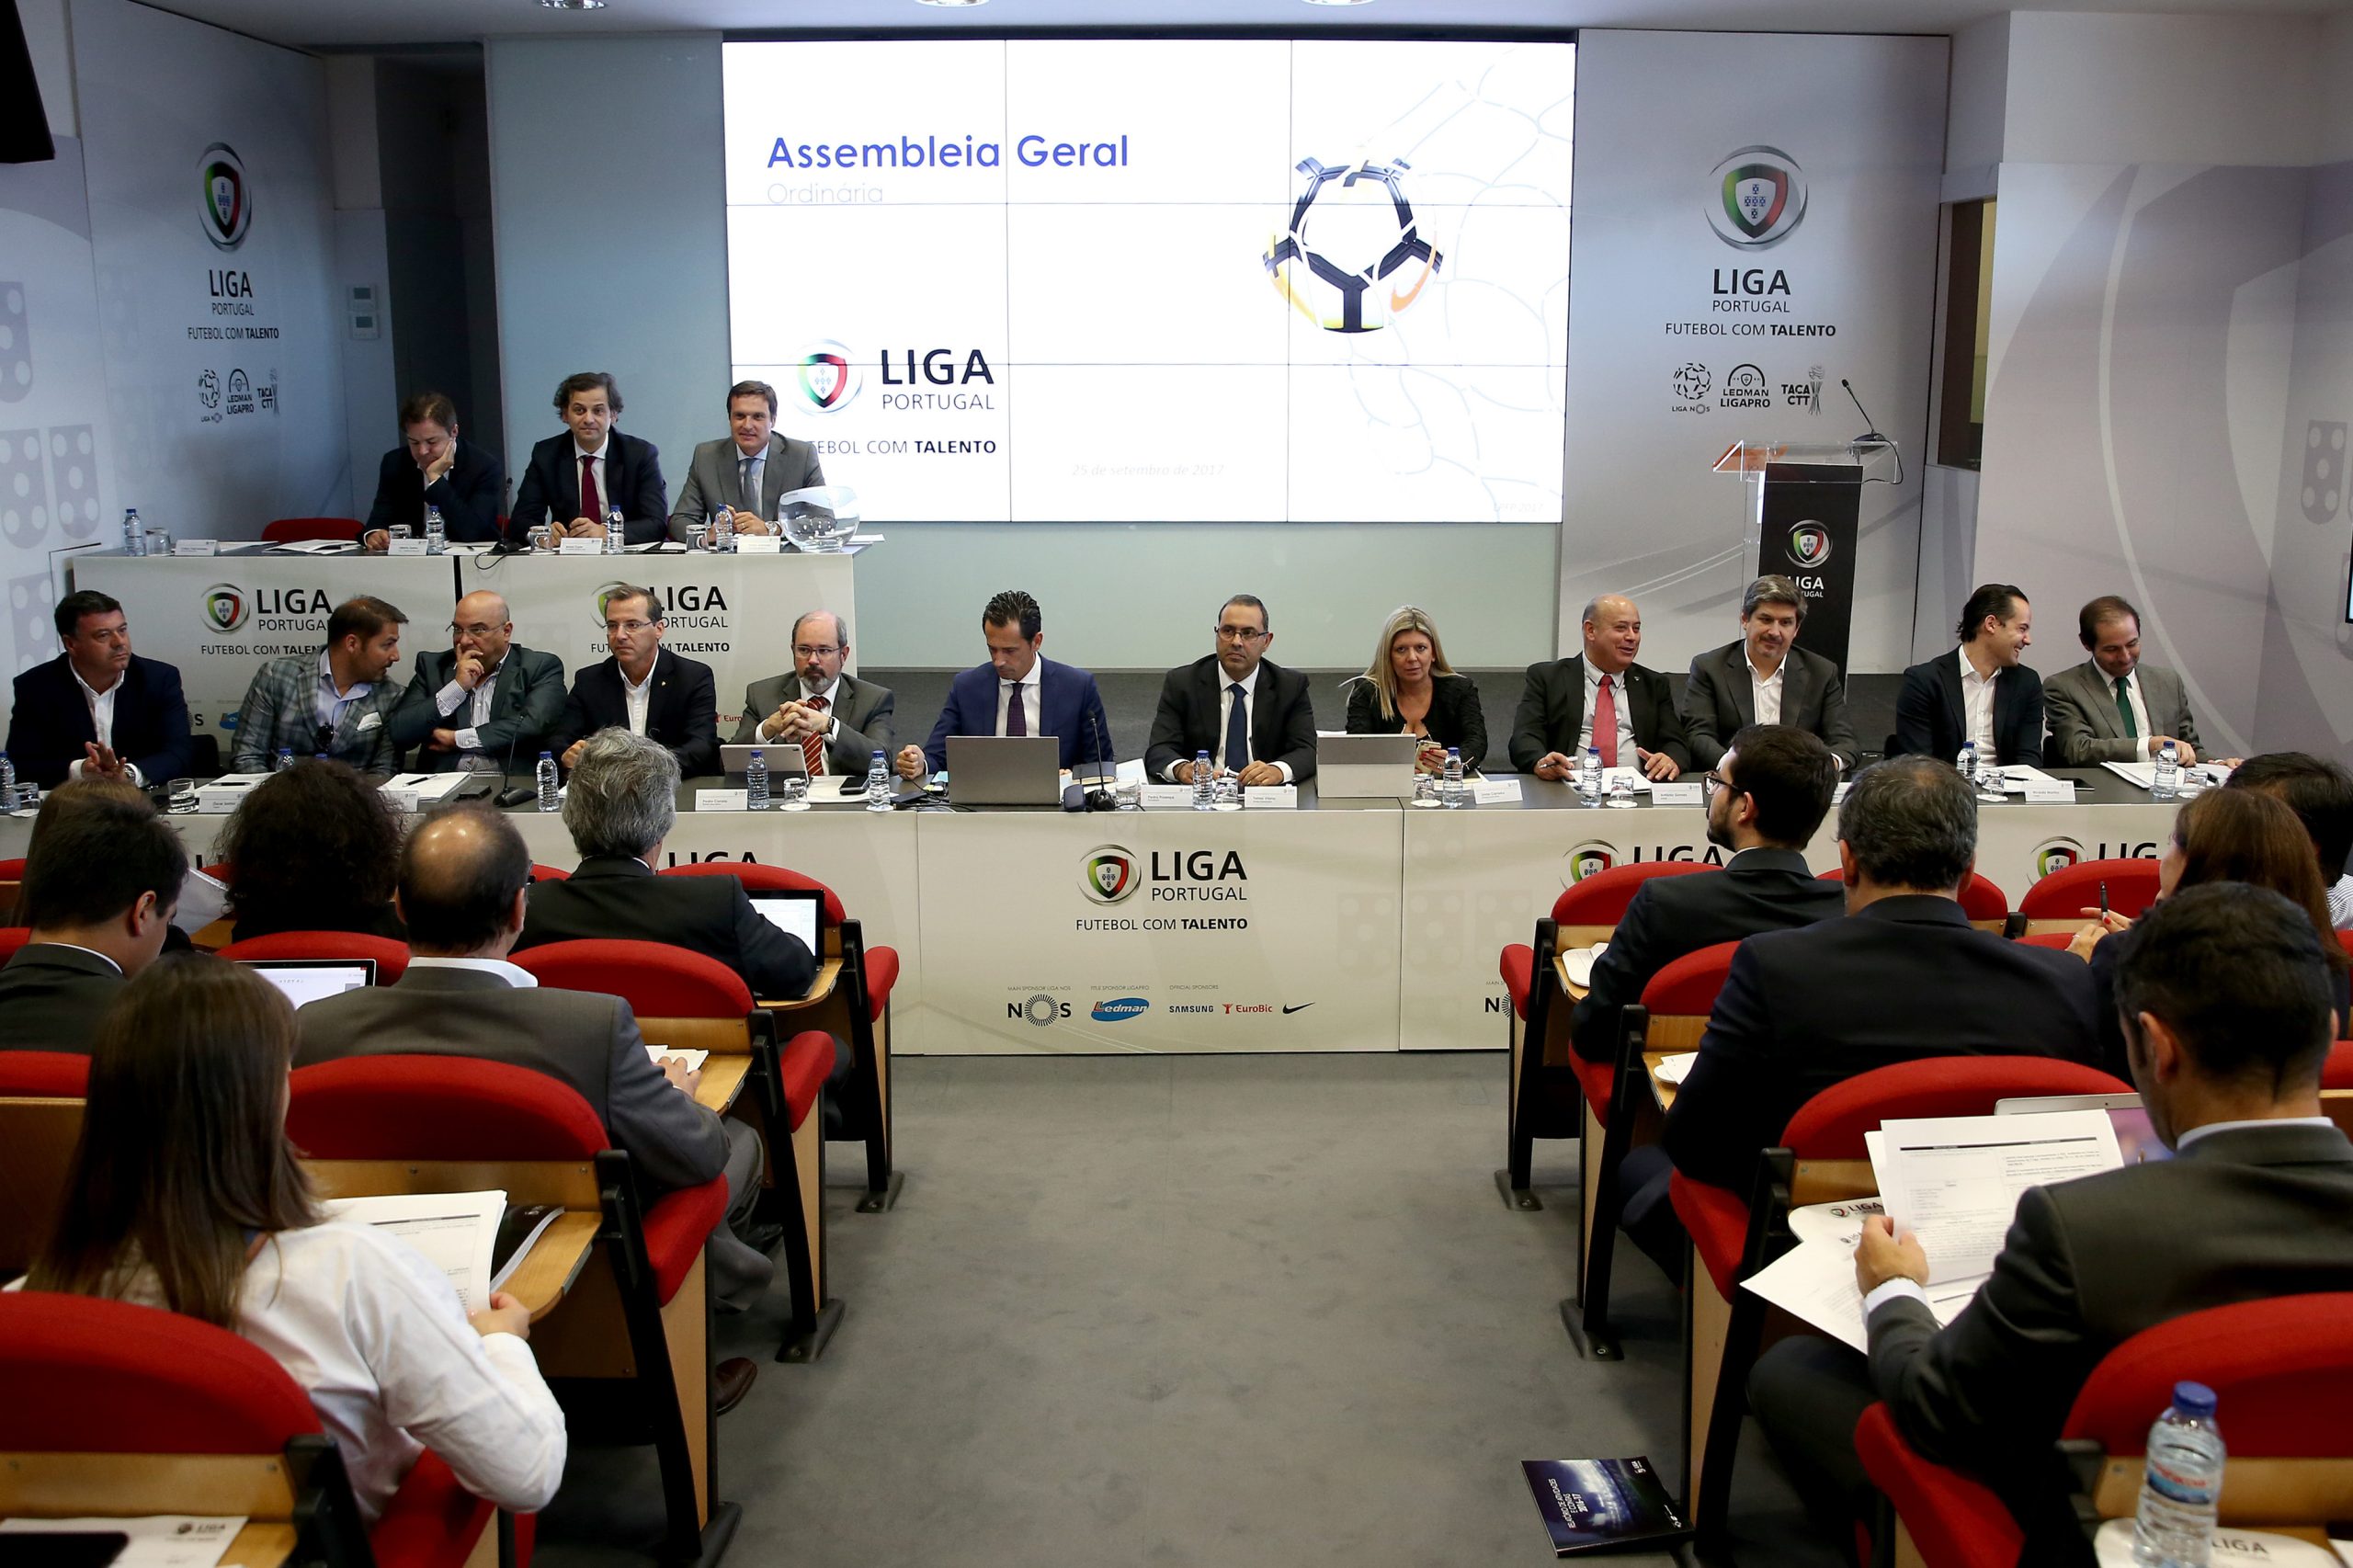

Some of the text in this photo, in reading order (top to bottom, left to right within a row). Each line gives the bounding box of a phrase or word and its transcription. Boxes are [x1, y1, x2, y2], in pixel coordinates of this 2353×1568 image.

[767, 134, 1129, 168] Assembleia Geral
[767, 183, 884, 204] Ordinária
[209, 269, 254, 298] LIGA
[1713, 268, 1791, 296] LIGA
[212, 302, 255, 316] PORTUGAL
[1712, 300, 1790, 313] PORTUGAL
[188, 326, 279, 340] FUTEBOL COM TALENTO
[1665, 323, 1836, 337] FUTEBOL COM TALENTO
[881, 348, 995, 385] LIGA
[1722, 388, 1769, 397] LEDMAN
[261, 398, 273, 409] CTT
[882, 393, 995, 411] PORTUGAL
[1720, 398, 1771, 408] LIGAPRO
[1787, 395, 1810, 405] CTT
[227, 403, 255, 415] LIGAPRO
[1689, 403, 1711, 415] NOS
[809, 440, 996, 454] EBOL COM TALENTO
[1788, 575, 1824, 589] IGA
[256, 588, 333, 614] LIGA
[258, 619, 329, 631] PORTUGA
[665, 616, 729, 629] ORTUGAL
[200, 644, 320, 655] FUTEBOL COM TALEN
[676, 642, 731, 653] TALENTO
[723, 714, 743, 722] Euro
[1152, 850, 1248, 881] LIGA
[1152, 886, 1247, 902] PORTUGAL
[1076, 917, 1248, 931] FUTEBOL COM TALENTO
[1007, 994, 1072, 1027] NOS
[1093, 1000, 1149, 1013] Ledman
[1169, 1005, 1214, 1014] SAMSUNG
[1235, 1004, 1273, 1013] EuroBic
[1847, 1201, 1883, 1212] LIGA
[2211, 1537, 2269, 1554] LIGA
